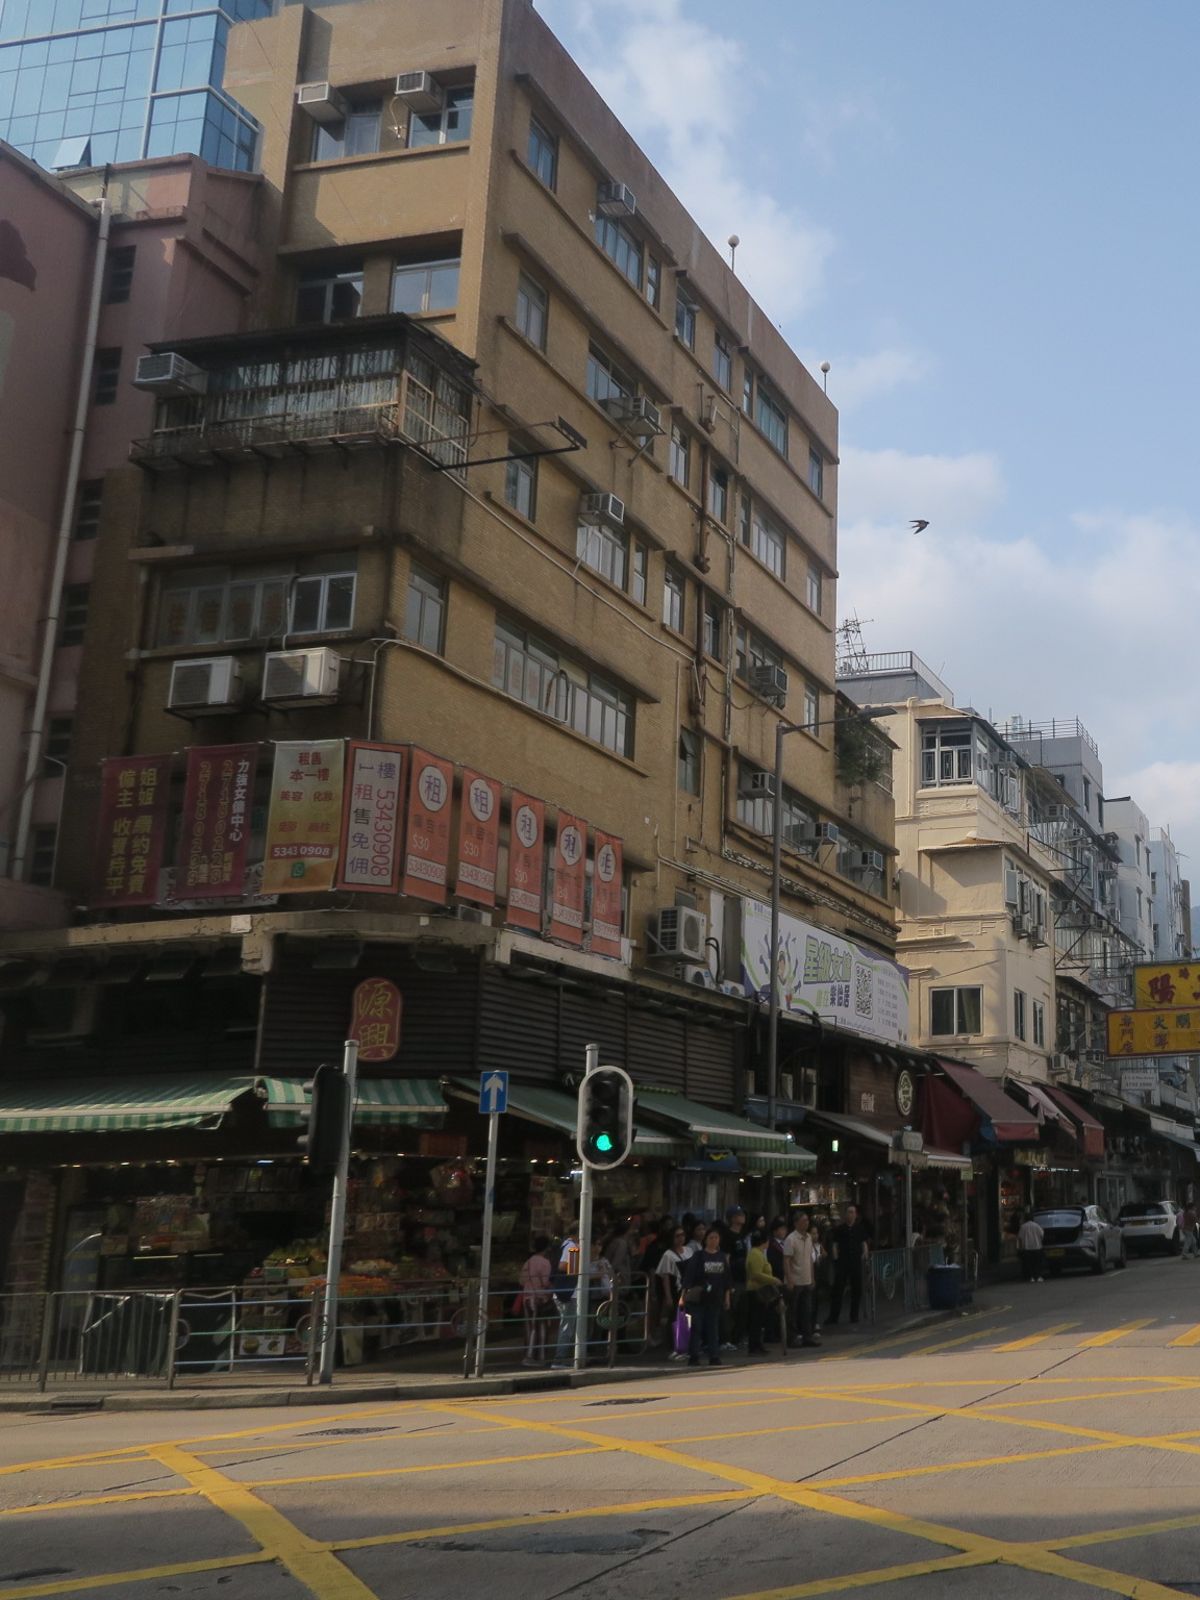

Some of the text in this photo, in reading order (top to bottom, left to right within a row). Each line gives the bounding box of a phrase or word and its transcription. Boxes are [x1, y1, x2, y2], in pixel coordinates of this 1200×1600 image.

[425, 775, 441, 804] 租
[474, 787, 489, 814] 租
[370, 788, 395, 877] 53430908
[272, 846, 330, 857] 5343 0908
[357, 983, 395, 1056] 源興
